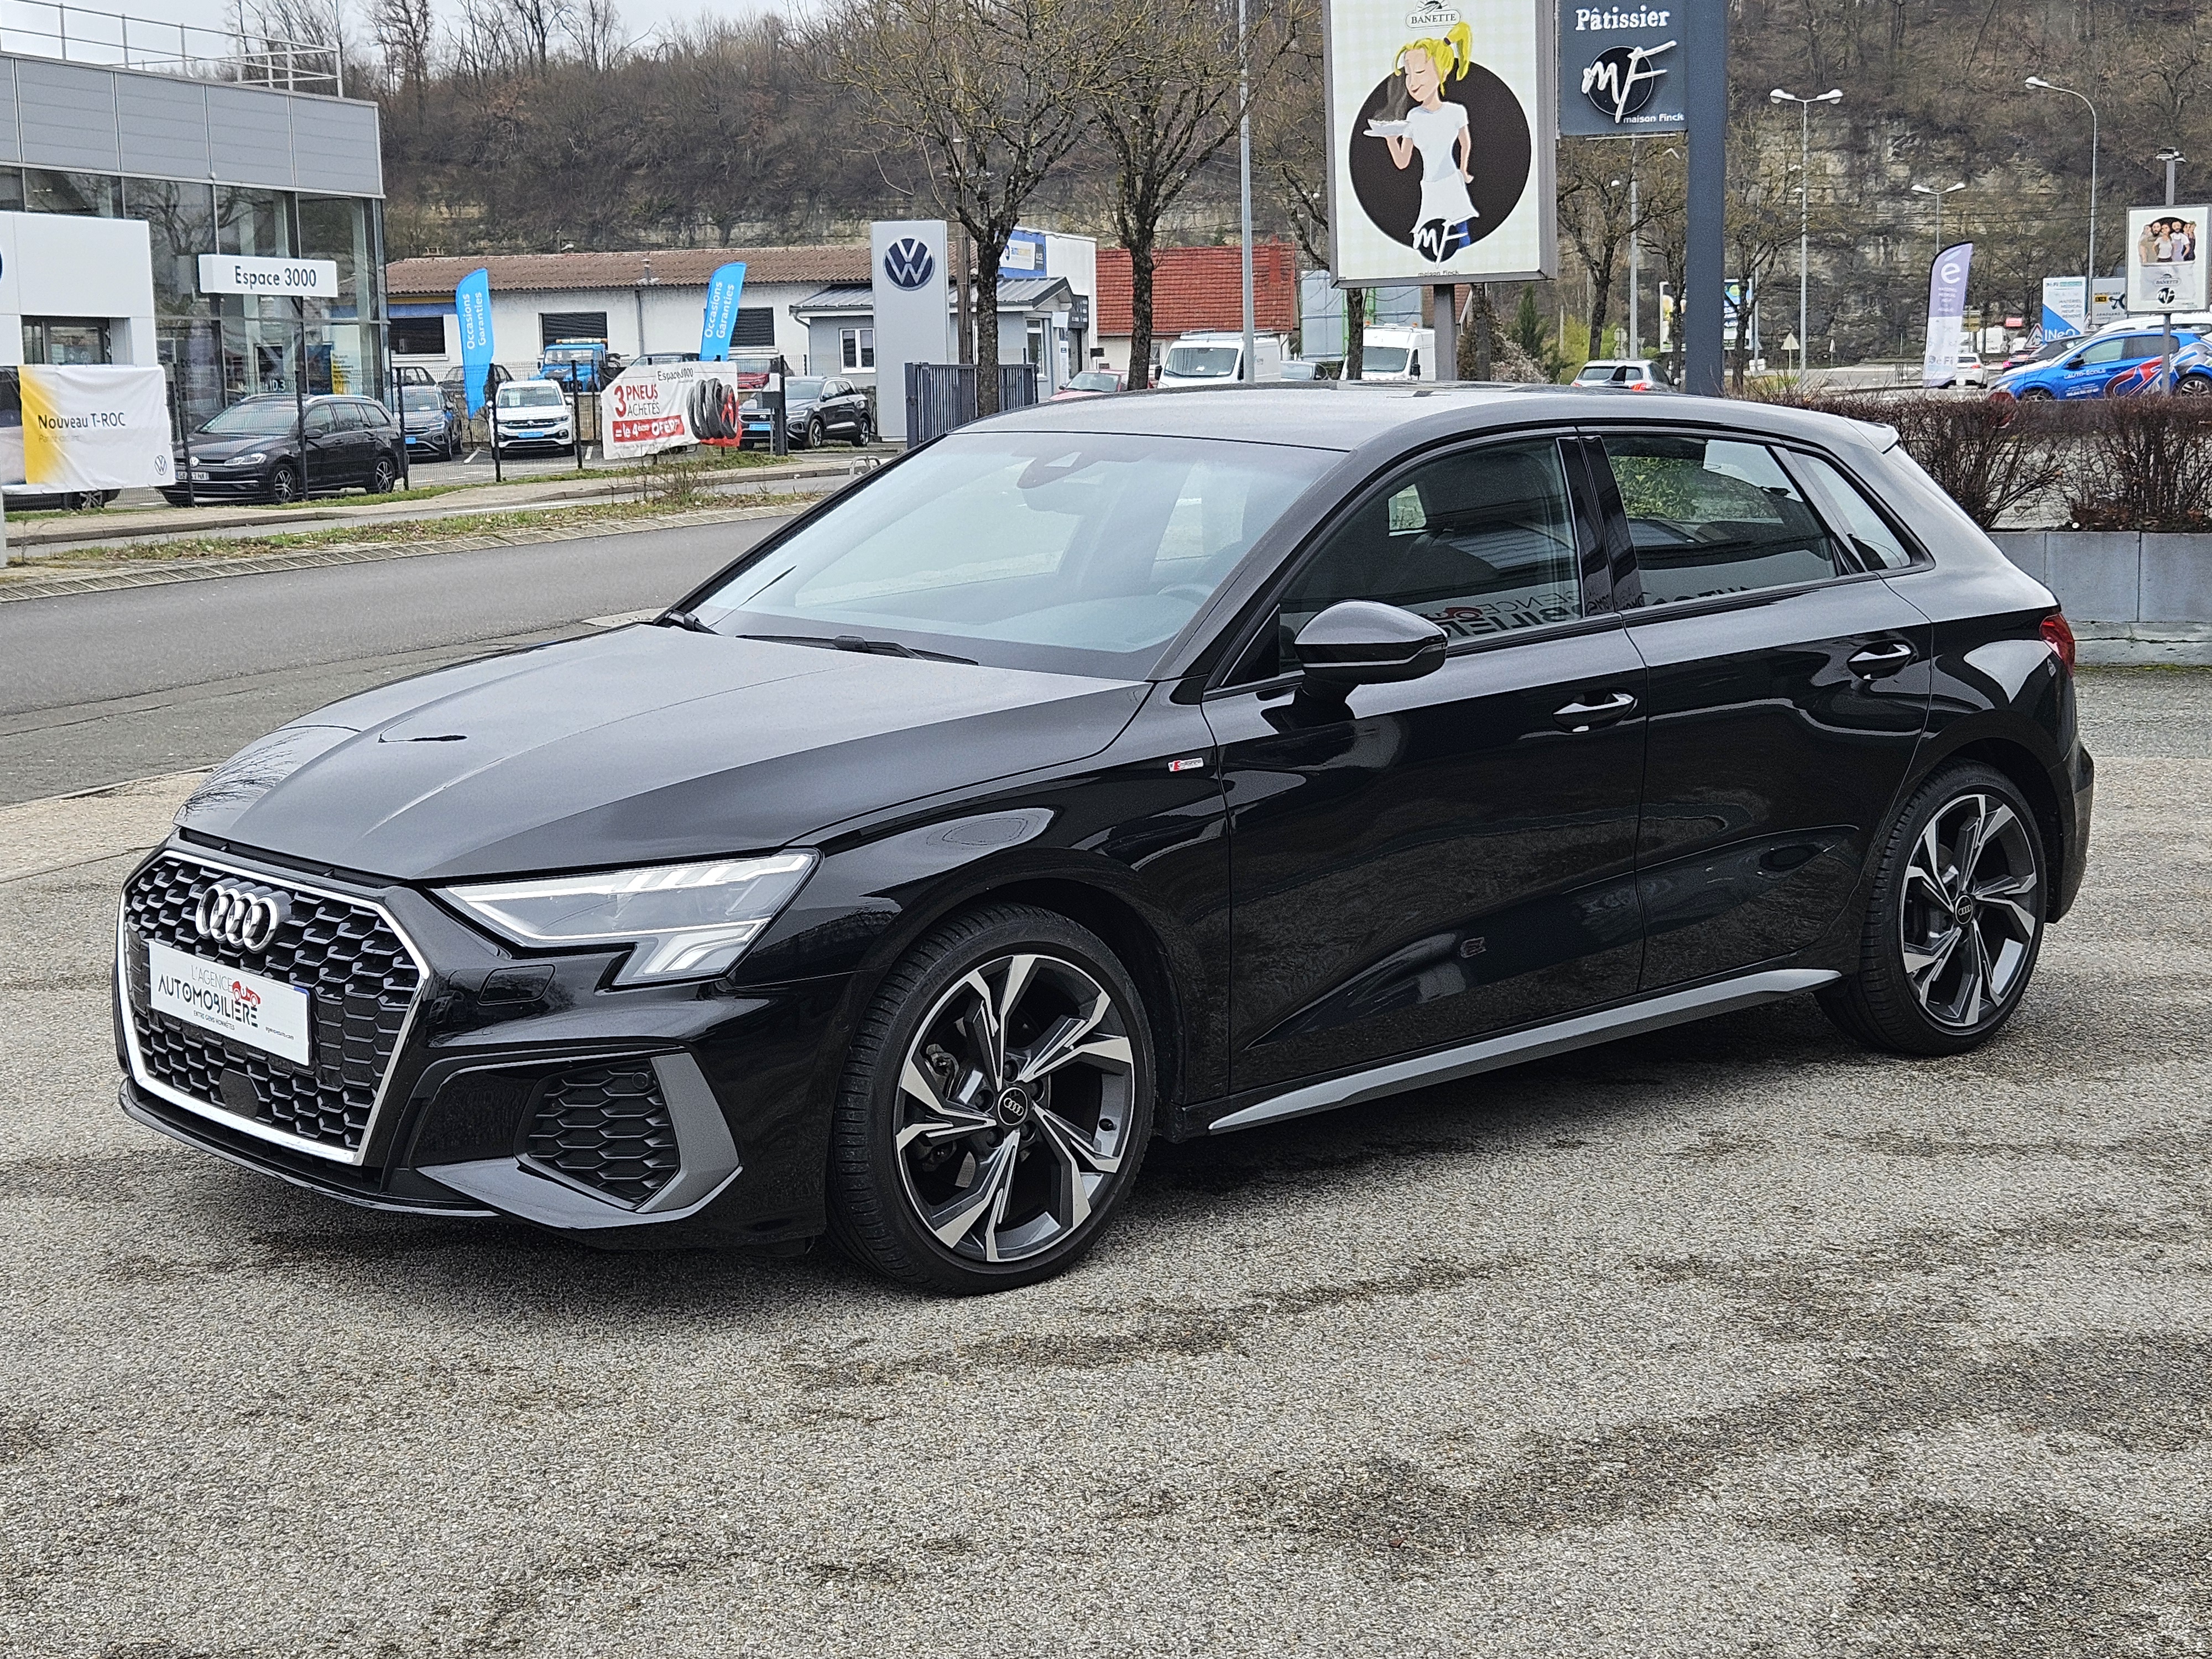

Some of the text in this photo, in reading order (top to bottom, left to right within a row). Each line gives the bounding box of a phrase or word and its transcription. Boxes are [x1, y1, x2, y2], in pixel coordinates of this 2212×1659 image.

[1411, 13, 1456, 24] BANETTE
[1575, 5, 1670, 30] Pâtissier
[1623, 114, 1656, 123] maison
[234, 265, 317, 290] Espace 3000
[463, 293, 475, 349] Occasions
[474, 291, 487, 346] Garanties
[704, 281, 722, 338] Occasions
[716, 284, 735, 338] Garanties
[614, 384, 659, 418] 3 PNEUS
[627, 399, 660, 416] ACHETÉS
[38, 412, 126, 429] Nouveau T-ROC
[623, 422, 632, 438] le
[191, 964, 233, 993] L'AGENCE
